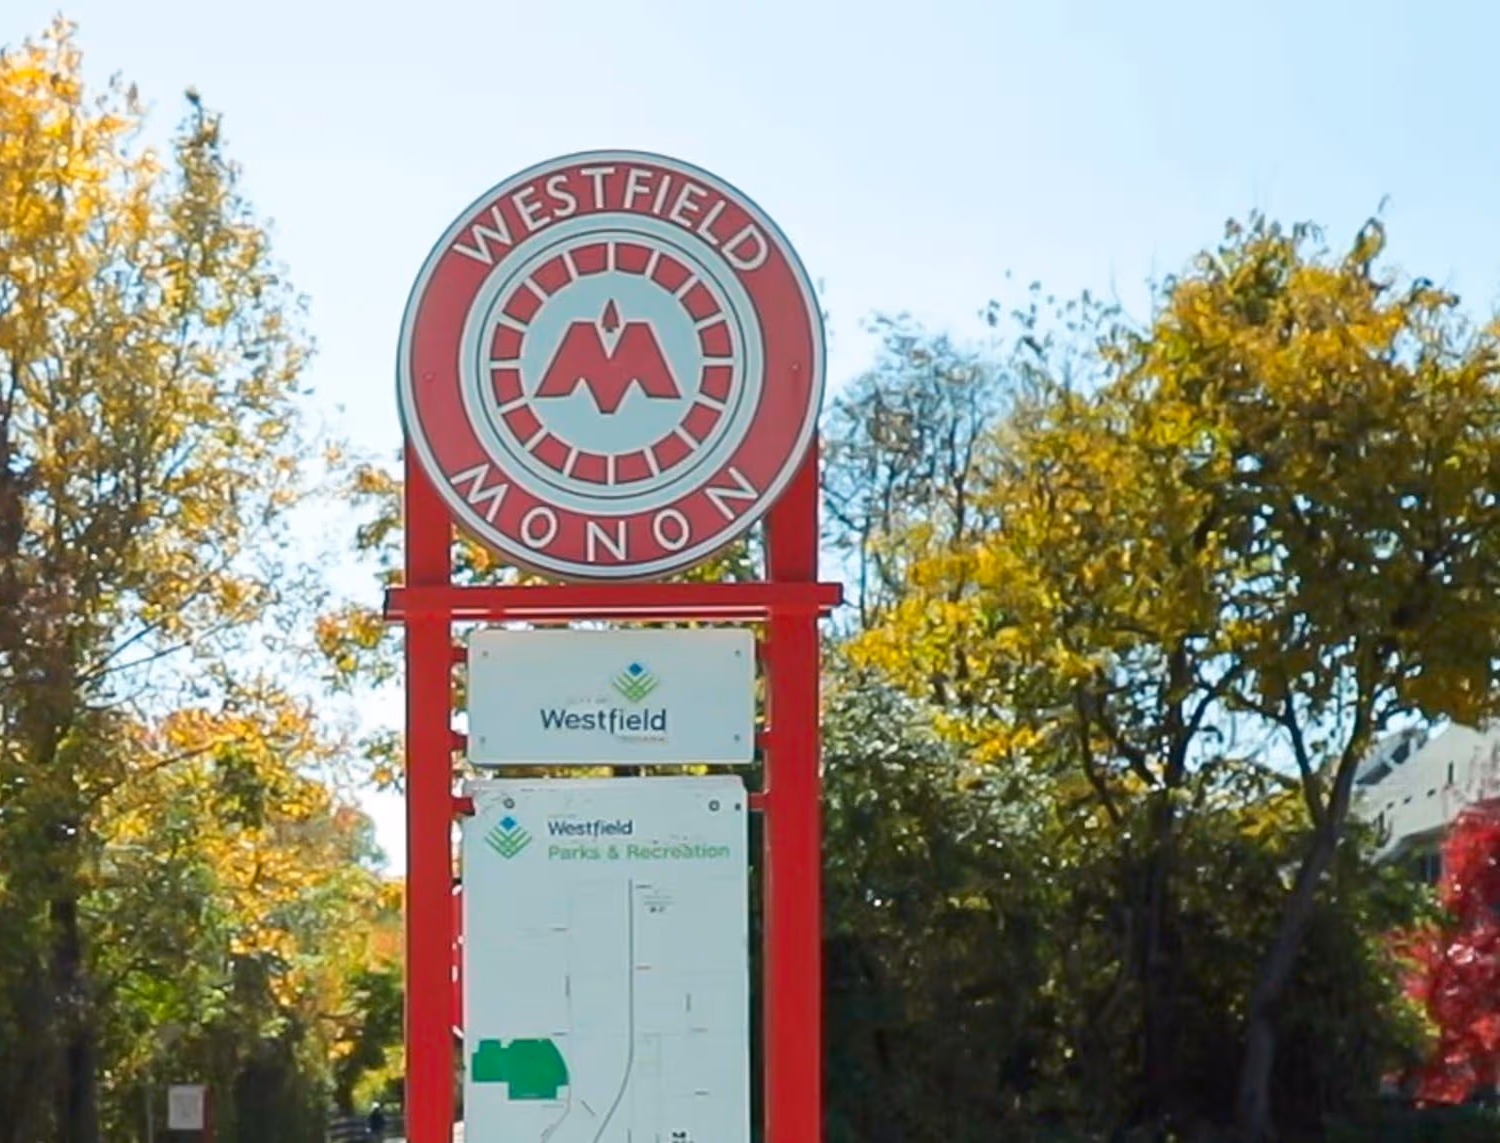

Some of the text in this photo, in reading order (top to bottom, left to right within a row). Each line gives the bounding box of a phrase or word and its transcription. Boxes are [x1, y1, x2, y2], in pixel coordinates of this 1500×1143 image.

[452, 166, 769, 271] WESTFIELD
[451, 464, 760, 563] MONON
[540, 708, 666, 734] Westfield
[547, 820, 633, 837] Westfield
[548, 843, 730, 860] Parks & Recreation
